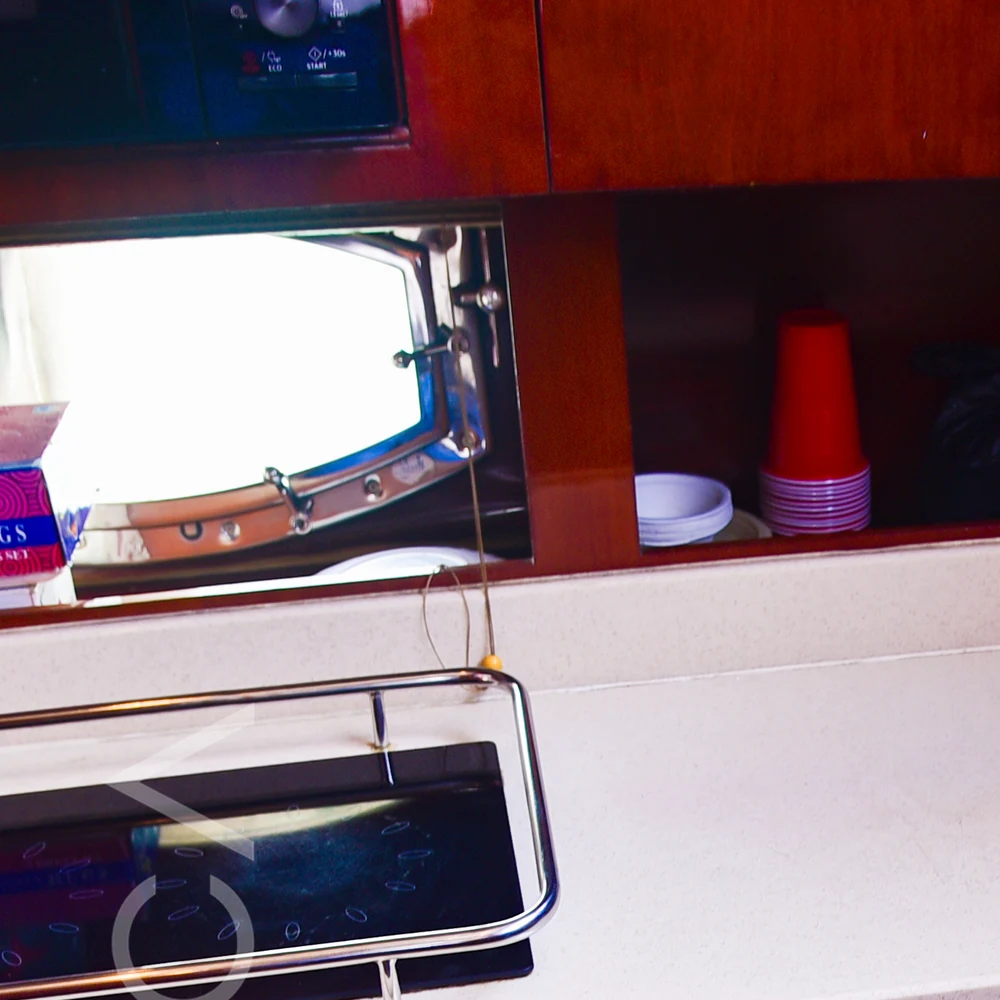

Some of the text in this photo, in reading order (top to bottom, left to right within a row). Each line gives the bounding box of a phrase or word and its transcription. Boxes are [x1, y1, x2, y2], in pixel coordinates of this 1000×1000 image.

[268, 63, 283, 72] ECO
[306, 61, 327, 70] START
[5, 549, 29, 561] SET
